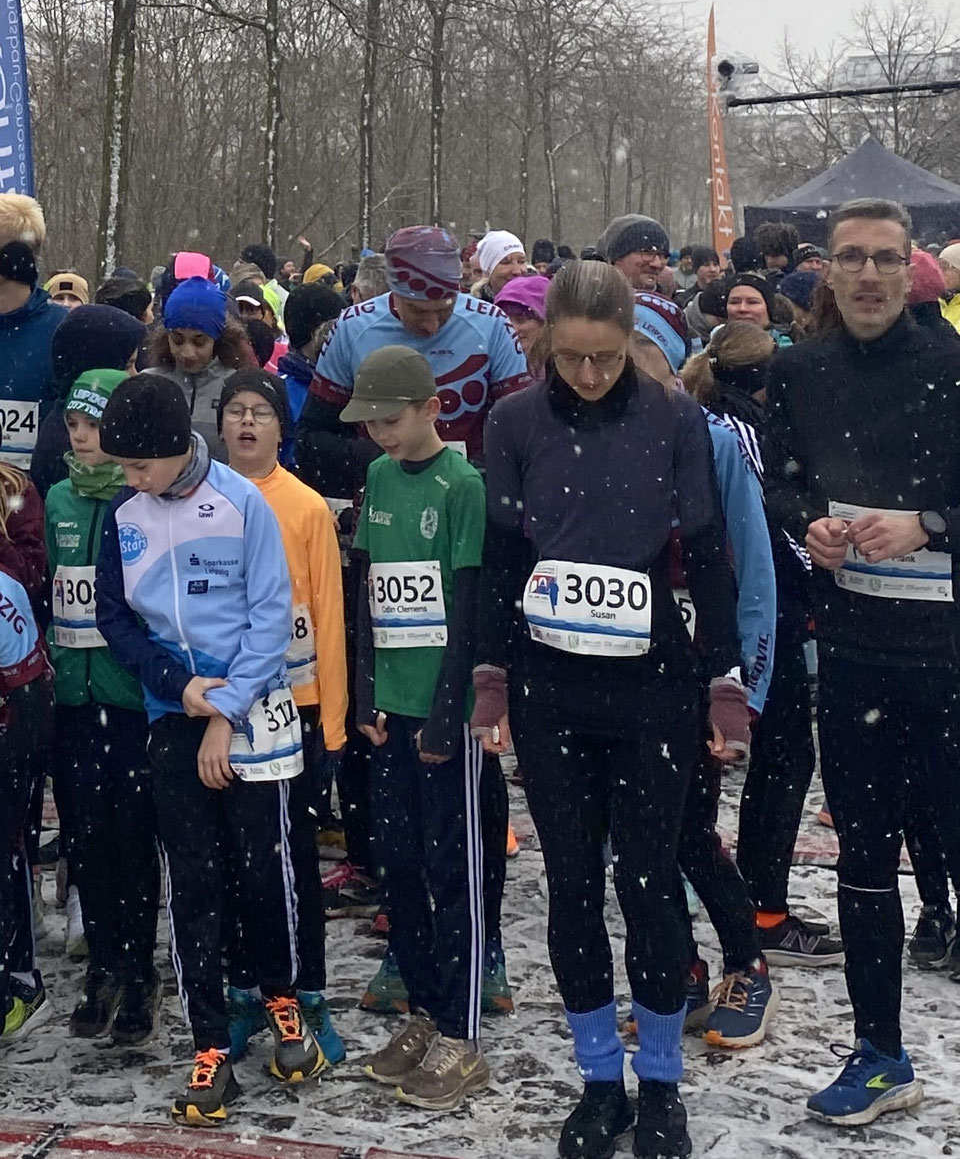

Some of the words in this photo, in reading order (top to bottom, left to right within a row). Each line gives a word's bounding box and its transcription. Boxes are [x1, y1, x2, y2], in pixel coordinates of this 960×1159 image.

[203, 559, 239, 567] Sparkasse
[376, 575, 437, 603] 3052
[564, 574, 648, 610] 3030
[397, 605, 428, 613] Clemens
[590, 609, 617, 620] Susan
